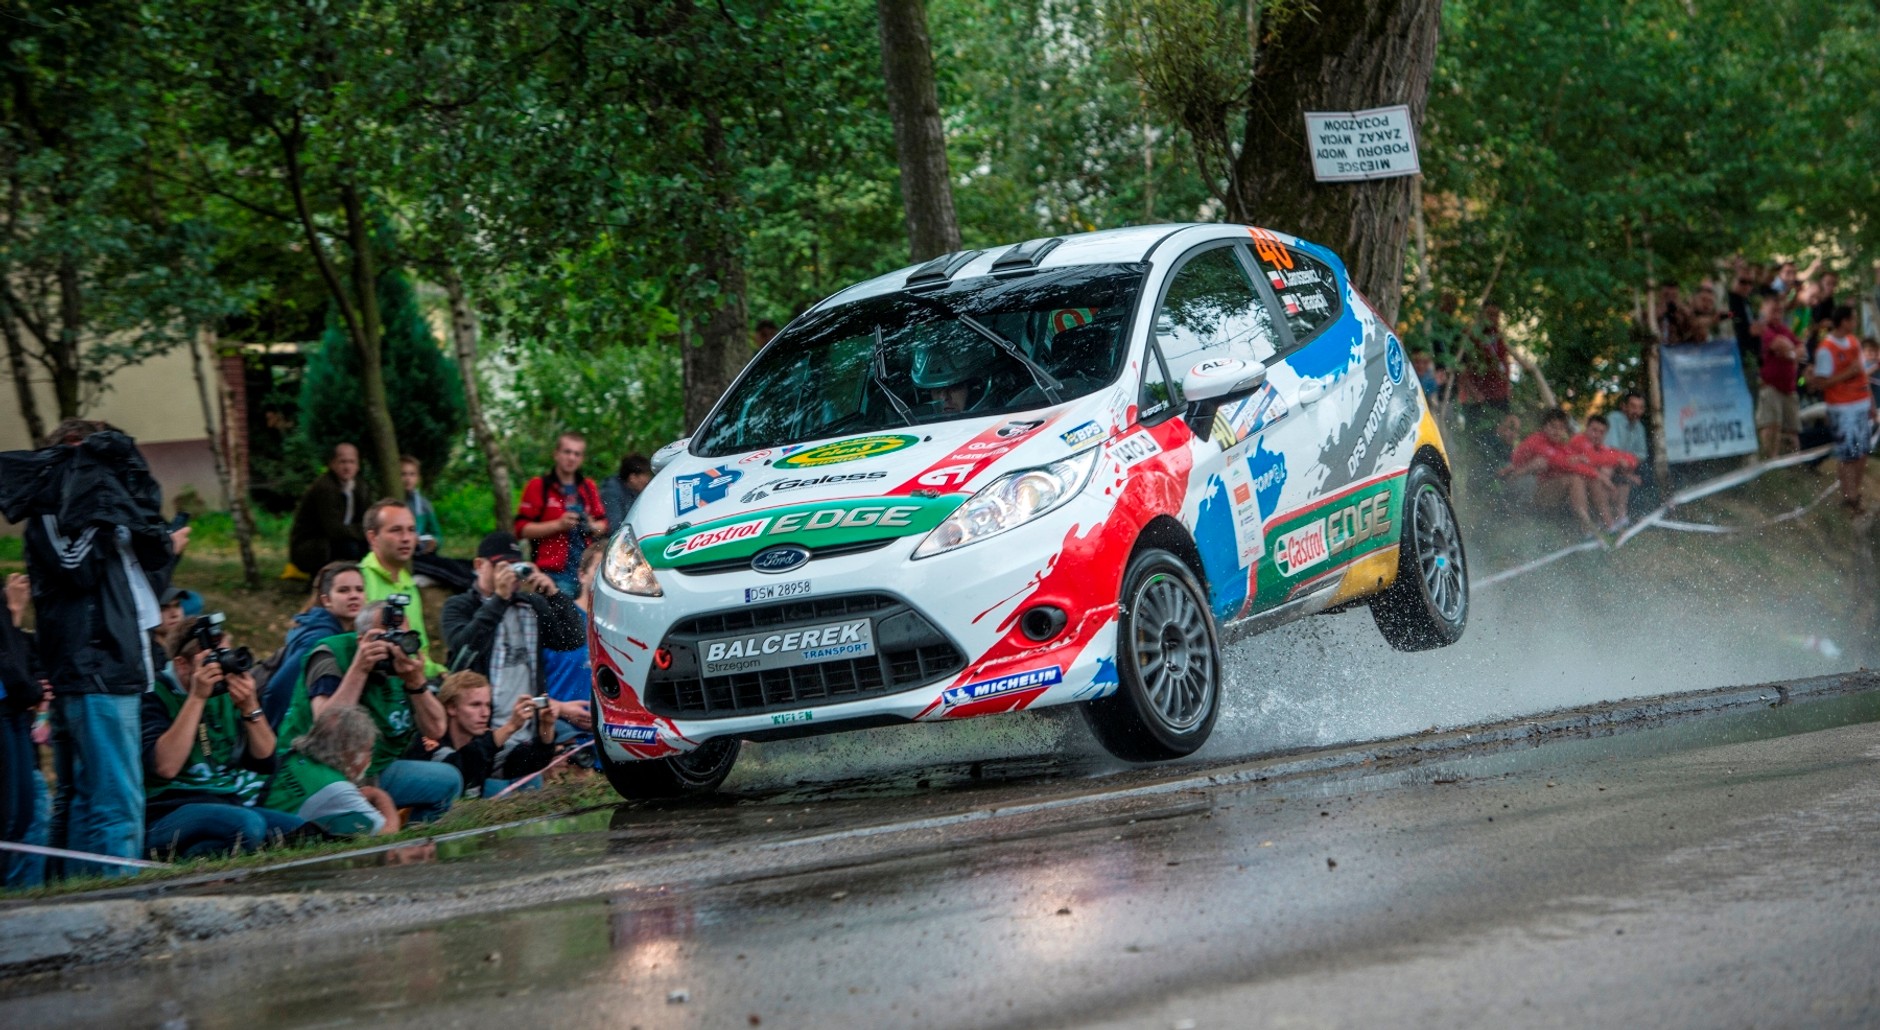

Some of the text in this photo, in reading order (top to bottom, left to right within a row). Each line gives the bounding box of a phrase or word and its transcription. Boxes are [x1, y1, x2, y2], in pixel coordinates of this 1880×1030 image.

[1324, 115, 1390, 132] POJAZDÓW
[1319, 128, 1402, 145] ZAKAZ MYCIA
[1316, 142, 1410, 159] POBORU WODY
[1338, 158, 1391, 173] MIEJSCE
[1347, 374, 1393, 478] DFS MOTORS
[1111, 440, 1145, 464] YATO
[772, 471, 888, 491] Galess
[686, 506, 922, 551] Castrol EDGE
[1288, 488, 1392, 569] Castrol EDGE
[758, 550, 796, 567] Ford
[751, 581, 811, 601] DSW 28958
[706, 620, 866, 663] BALCEREK
[803, 642, 869, 660] TRANSPORT
[706, 658, 761, 674] Strzegom
[973, 668, 1057, 697] MICHELIN
[610, 727, 654, 740] MICHELIN
